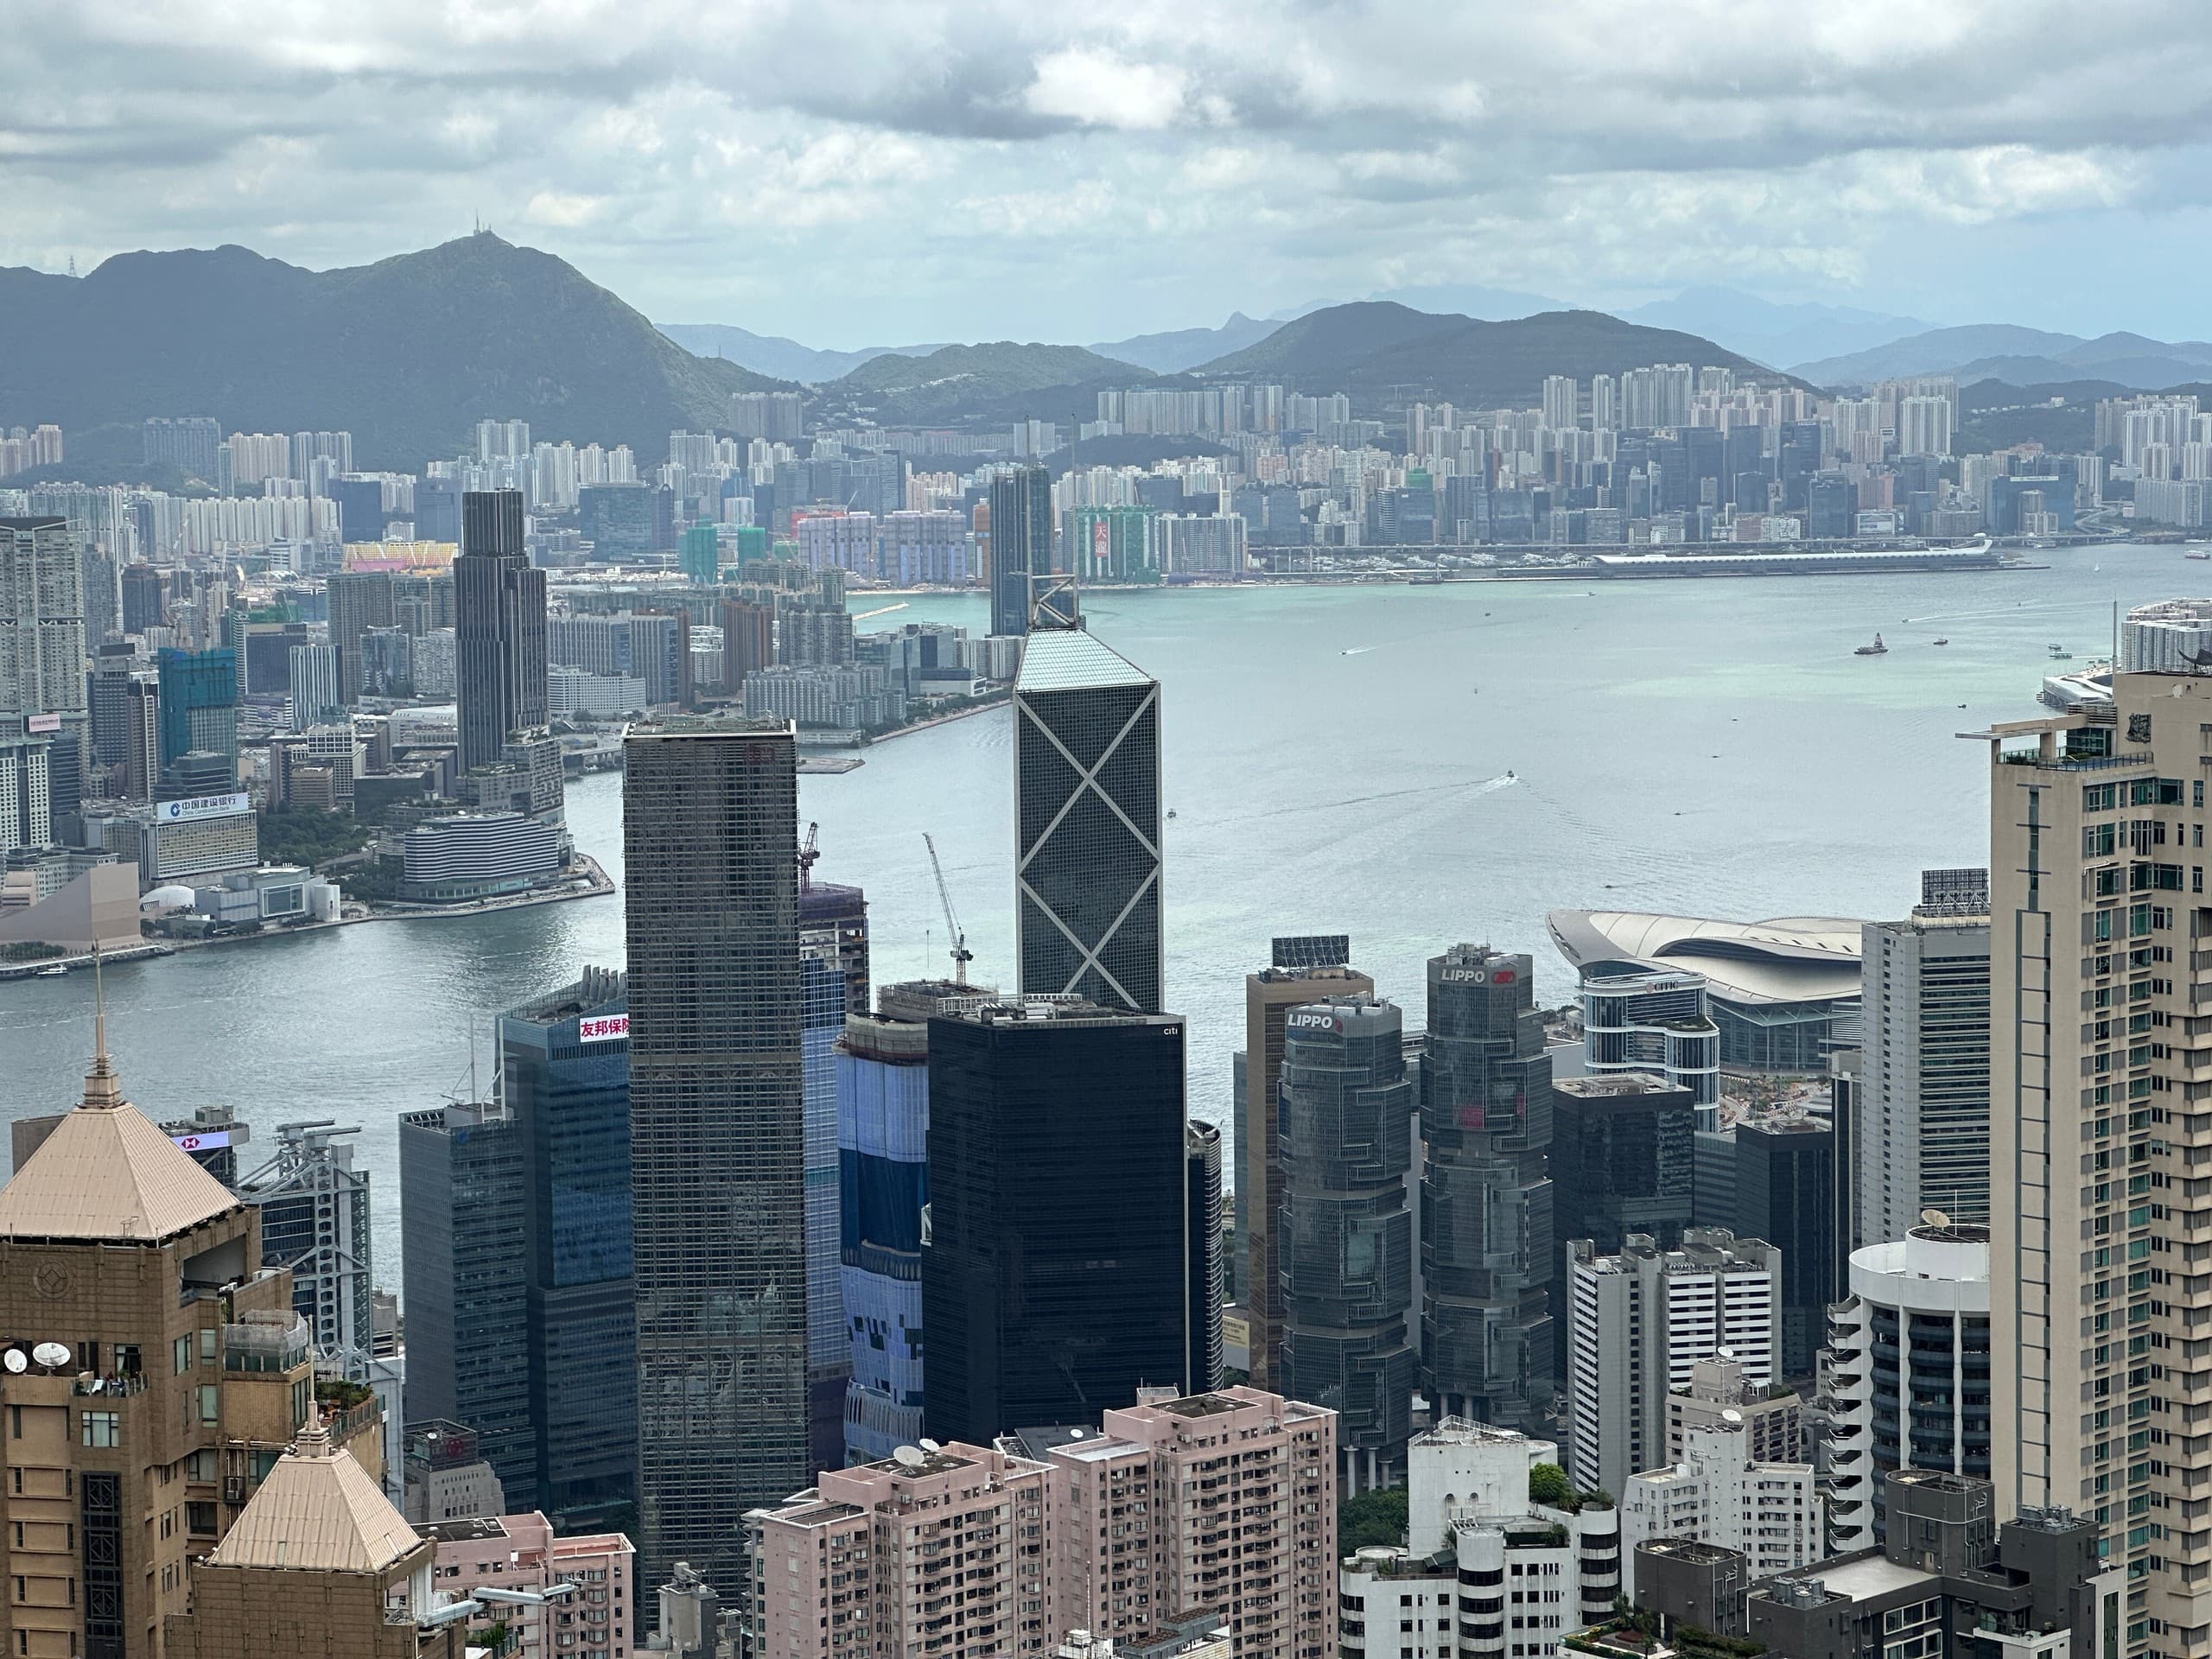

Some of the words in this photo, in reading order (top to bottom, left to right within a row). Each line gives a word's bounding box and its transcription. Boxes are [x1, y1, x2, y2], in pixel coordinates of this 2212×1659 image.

[181, 795, 236, 810] 中国建设银行
[1442, 969, 1485, 983] LIPPO
[1654, 981, 1678, 991] CITIC
[1287, 1014, 1332, 1029] LIPPO
[1163, 1027, 1178, 1035] citi
